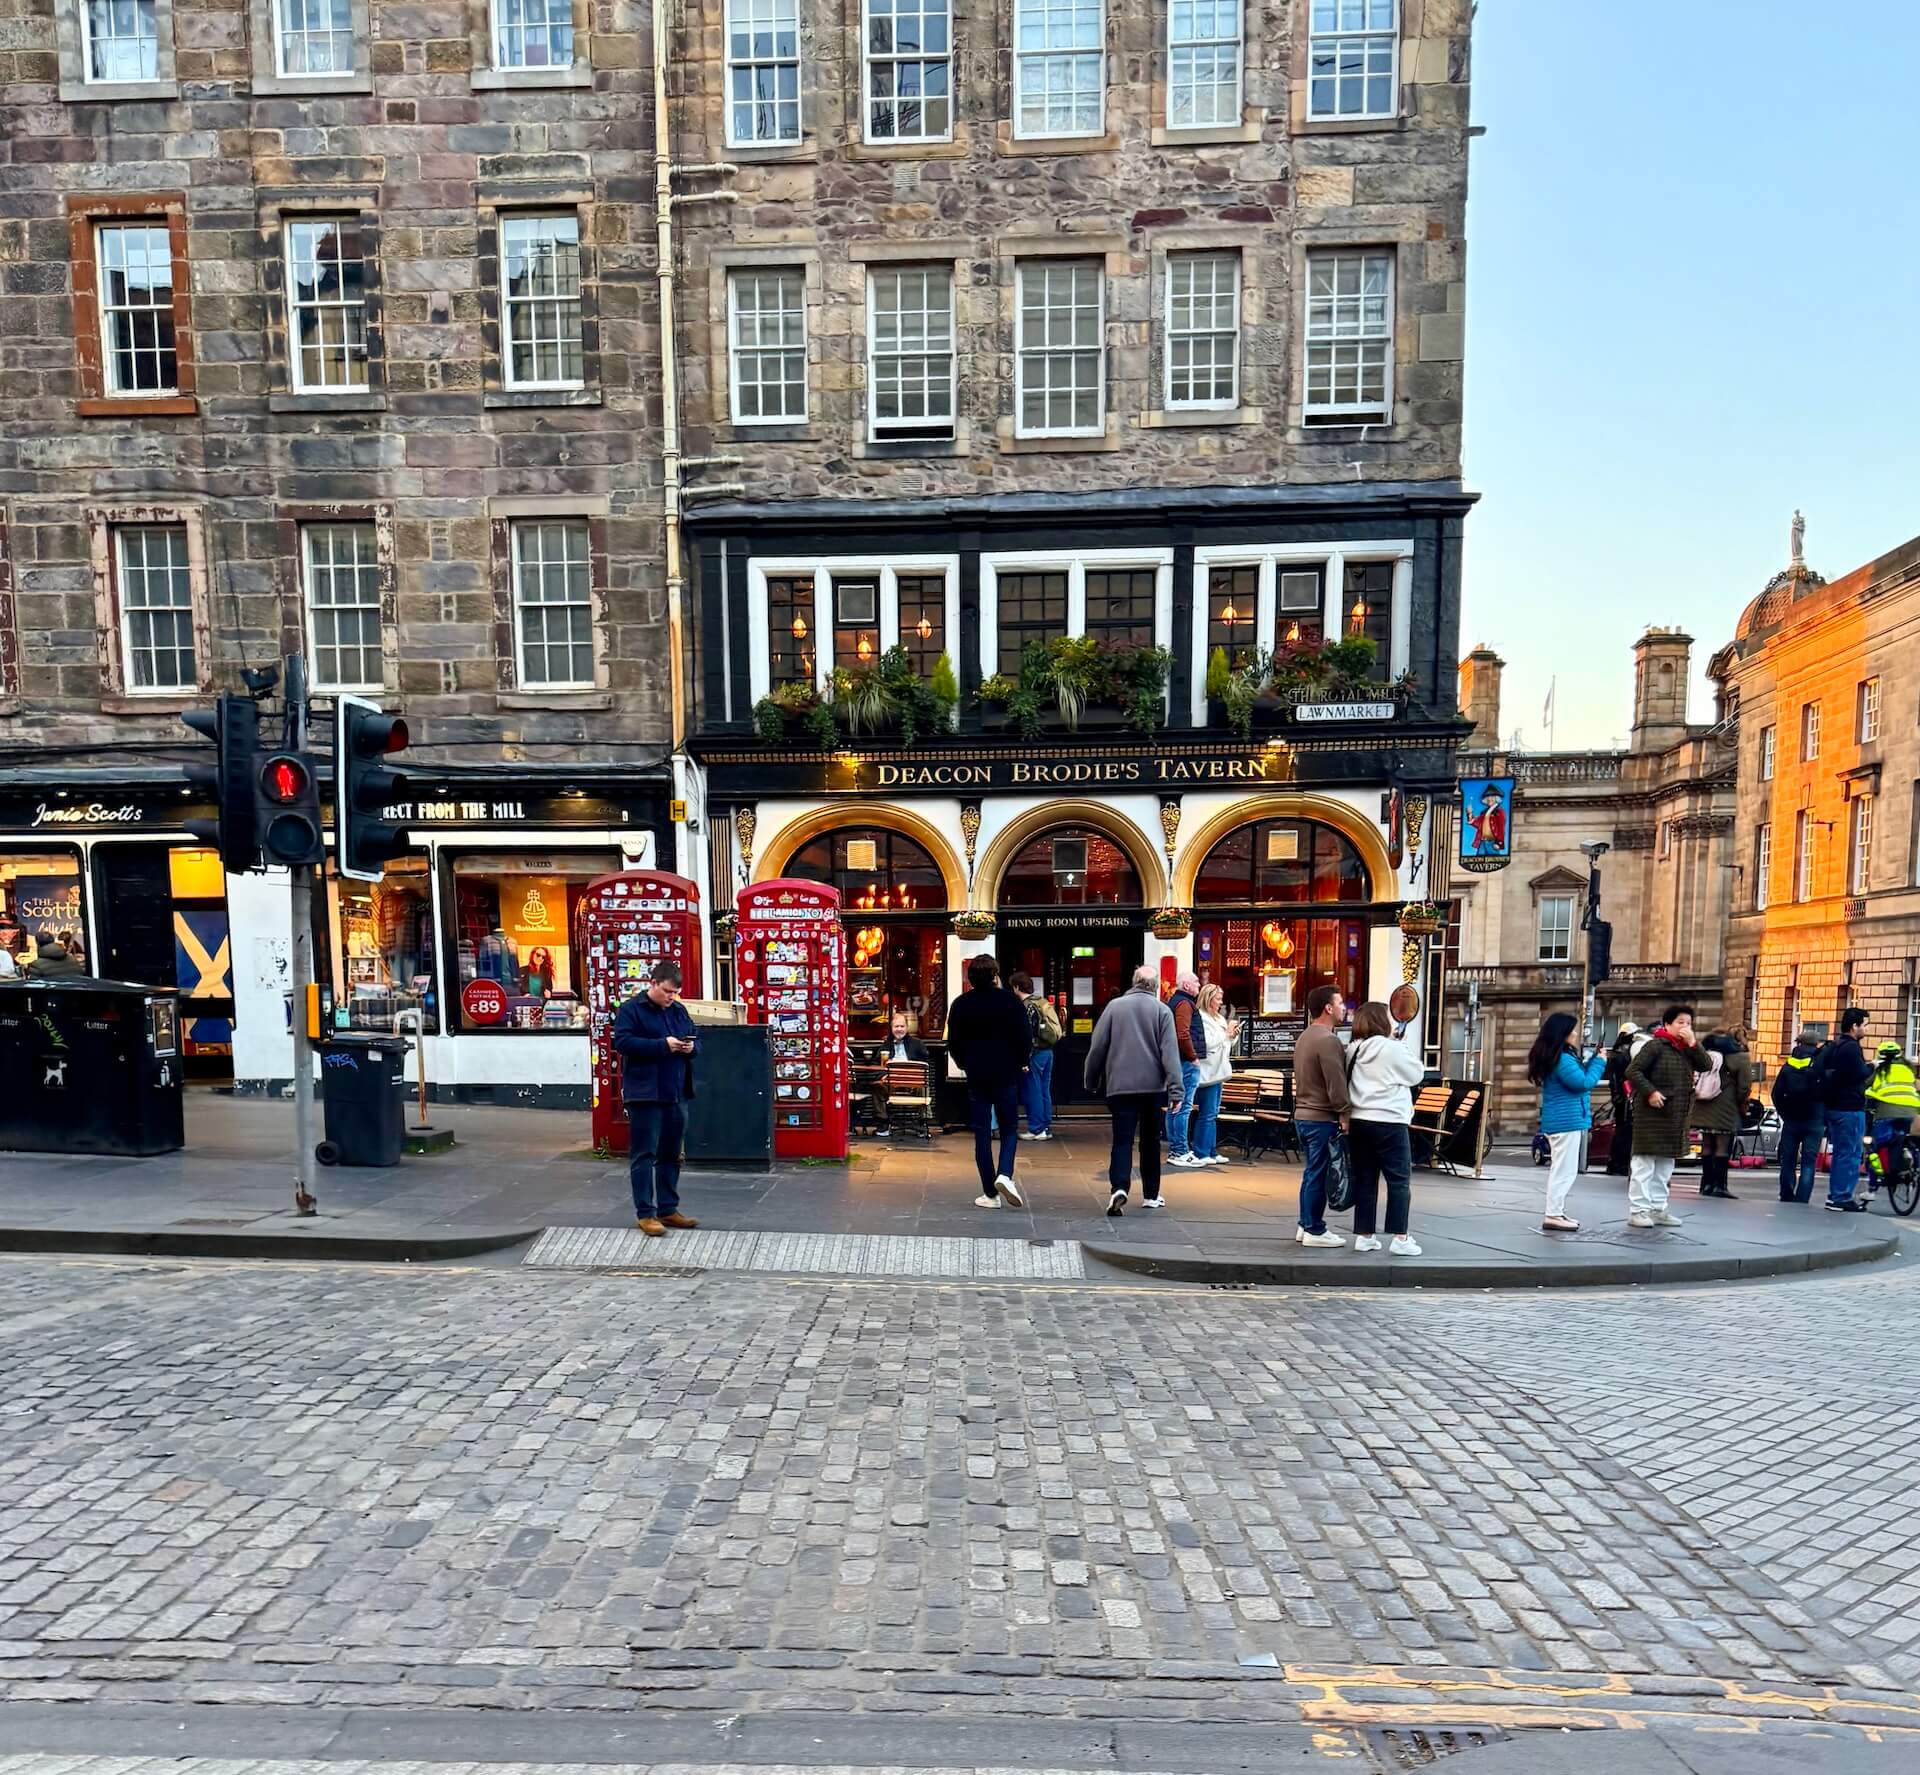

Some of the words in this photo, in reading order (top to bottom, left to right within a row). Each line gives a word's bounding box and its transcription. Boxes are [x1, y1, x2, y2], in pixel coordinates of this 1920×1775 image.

[1299, 705, 1392, 719] LAWNMARKET
[878, 765, 993, 785] DEACON
[1011, 763, 1140, 782] BRODIE'S
[1154, 759, 1268, 780] TAVERN
[381, 803, 412, 819] RECT
[418, 802, 455, 819] FROM
[461, 802, 487, 819] THE
[492, 802, 525, 819] MILL
[1470, 863, 1502, 871] TAVERN
[1007, 919, 1041, 928] DINING
[1046, 918, 1078, 927] ROOM
[1082, 917, 1130, 927] UPSTAIRS
[470, 1000, 500, 1013] £89
